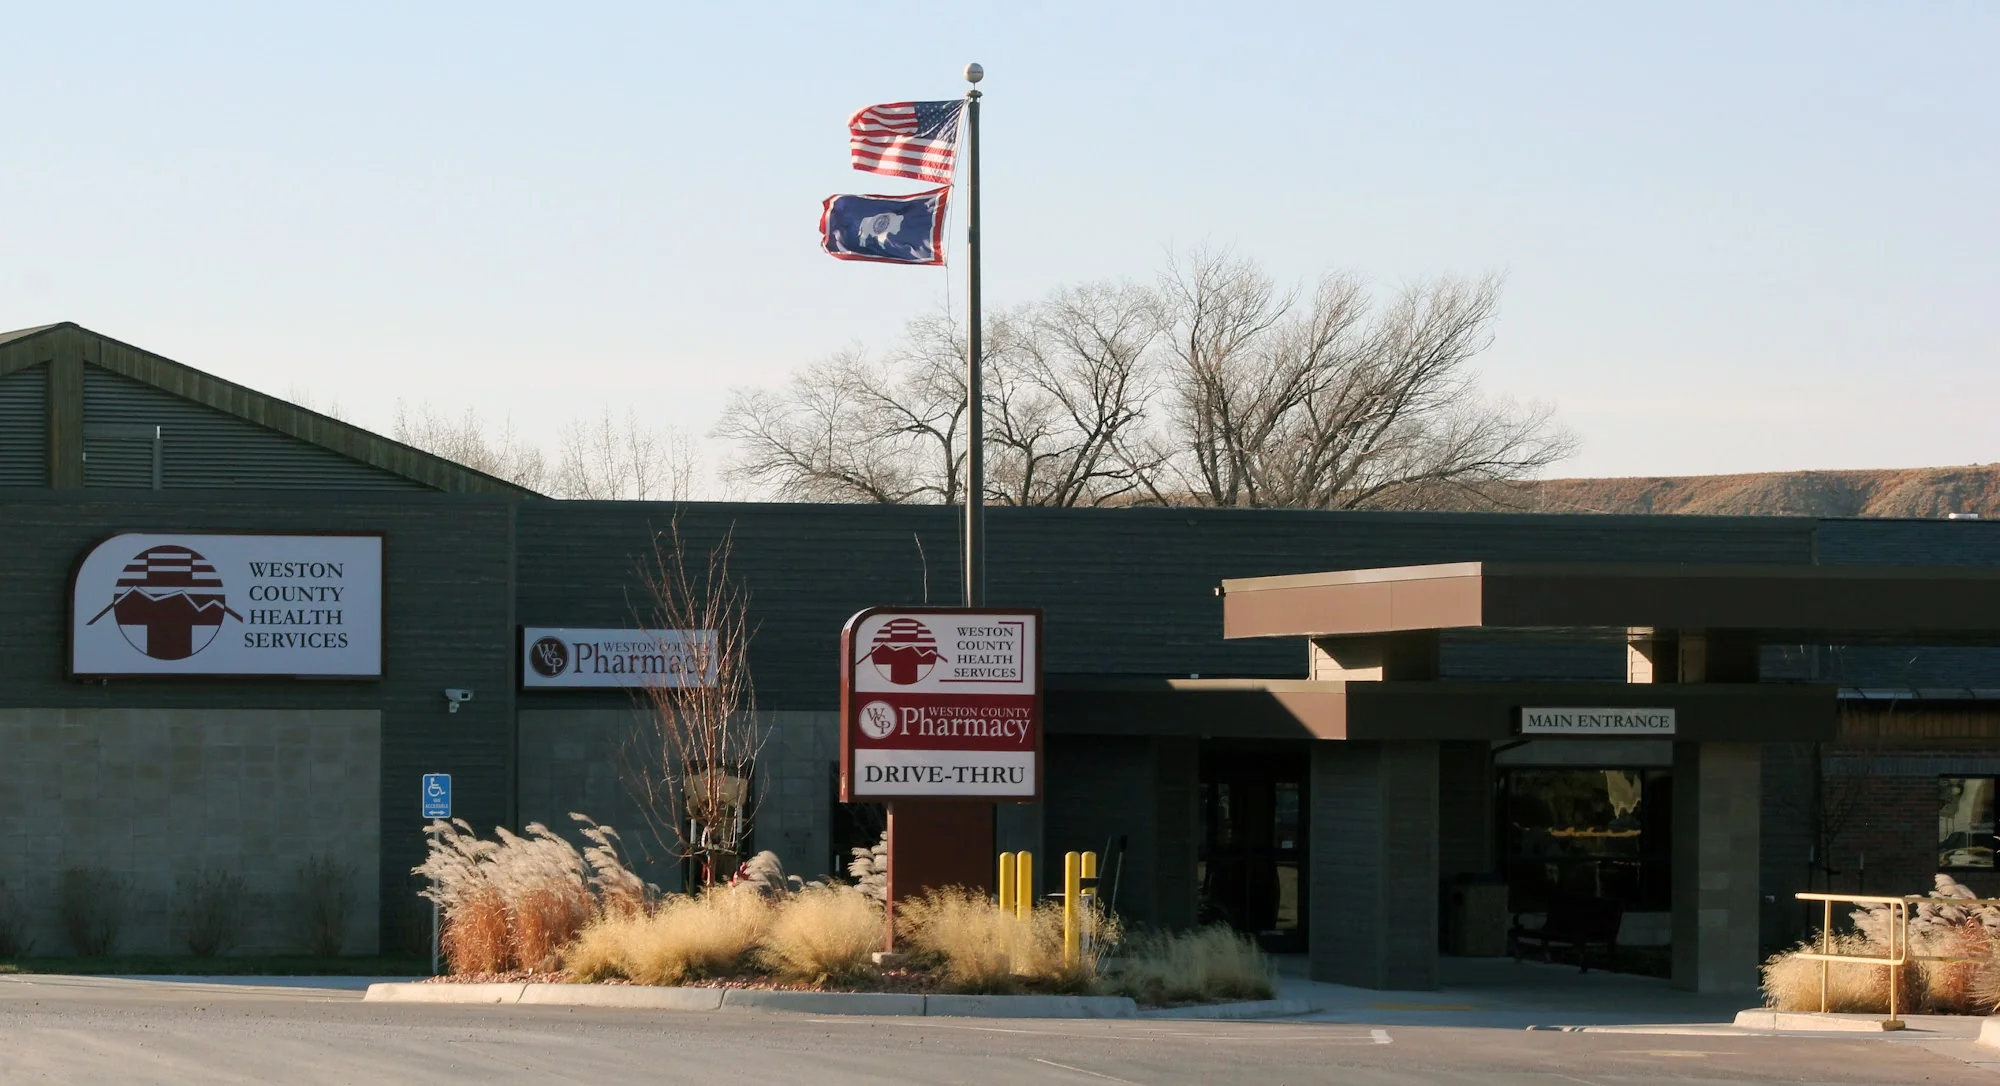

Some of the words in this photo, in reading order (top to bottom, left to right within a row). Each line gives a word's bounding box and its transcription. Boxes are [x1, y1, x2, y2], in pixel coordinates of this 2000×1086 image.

[249, 562, 344, 578] WESTON
[249, 586, 344, 602] COUNTY
[249, 609, 343, 626] HEALTH
[956, 627, 1014, 637] WESTON
[244, 632, 348, 649] SERVICES
[604, 642, 656, 653] WESTON
[956, 640, 1014, 651] COUNTY
[572, 642, 714, 681] Pharmac
[957, 654, 1013, 665] HEALTH
[954, 667, 1016, 678] SERVICES
[928, 706, 978, 717] WESTON
[980, 707, 1031, 718] COUNTY
[899, 706, 1031, 744] Pharmacy
[1528, 714, 1573, 728] MAIN
[1578, 715, 1670, 729] ENTRANCE
[865, 765, 1025, 784] DRIVE-THRU
